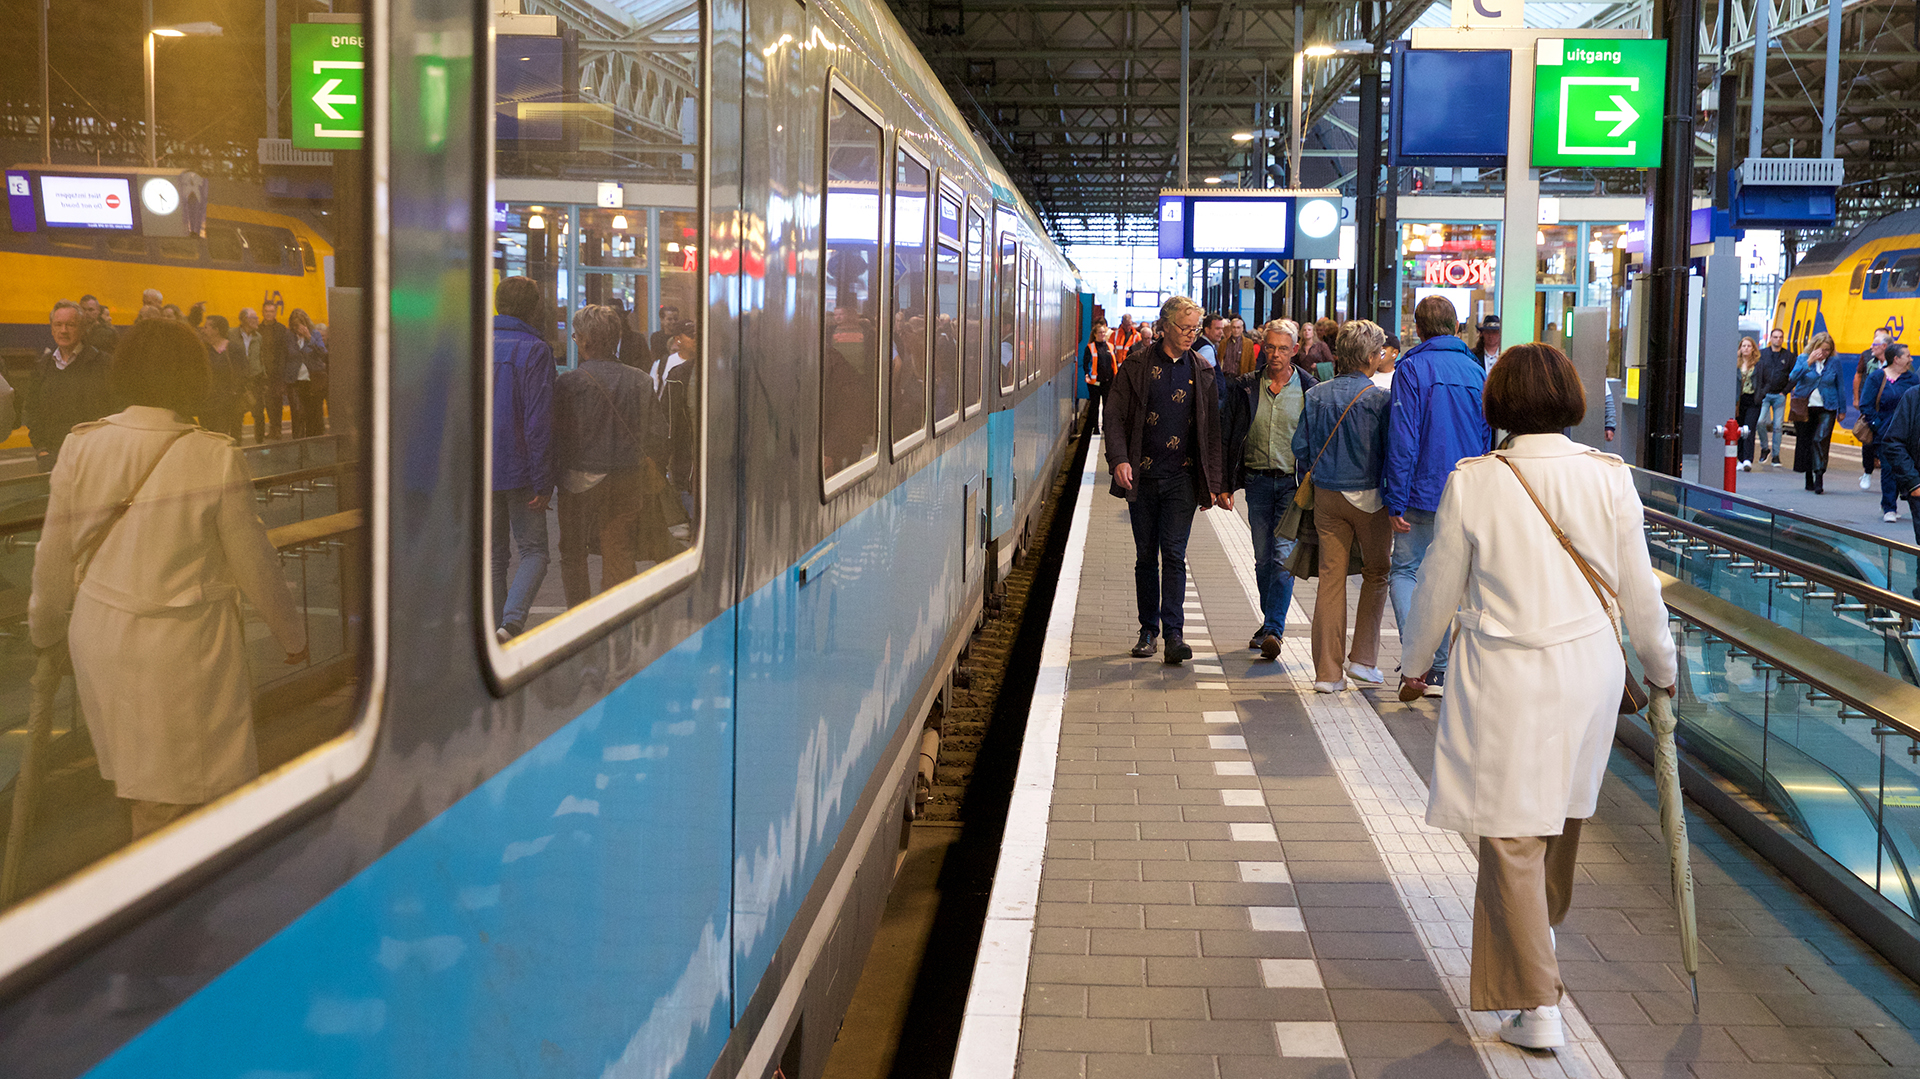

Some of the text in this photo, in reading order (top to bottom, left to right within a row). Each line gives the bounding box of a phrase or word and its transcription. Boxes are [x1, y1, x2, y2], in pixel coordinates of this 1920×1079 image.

[1567, 48, 1621, 64] uitgang
[1268, 269, 1280, 283] 2
[1424, 258, 1493, 286] KIOSK
